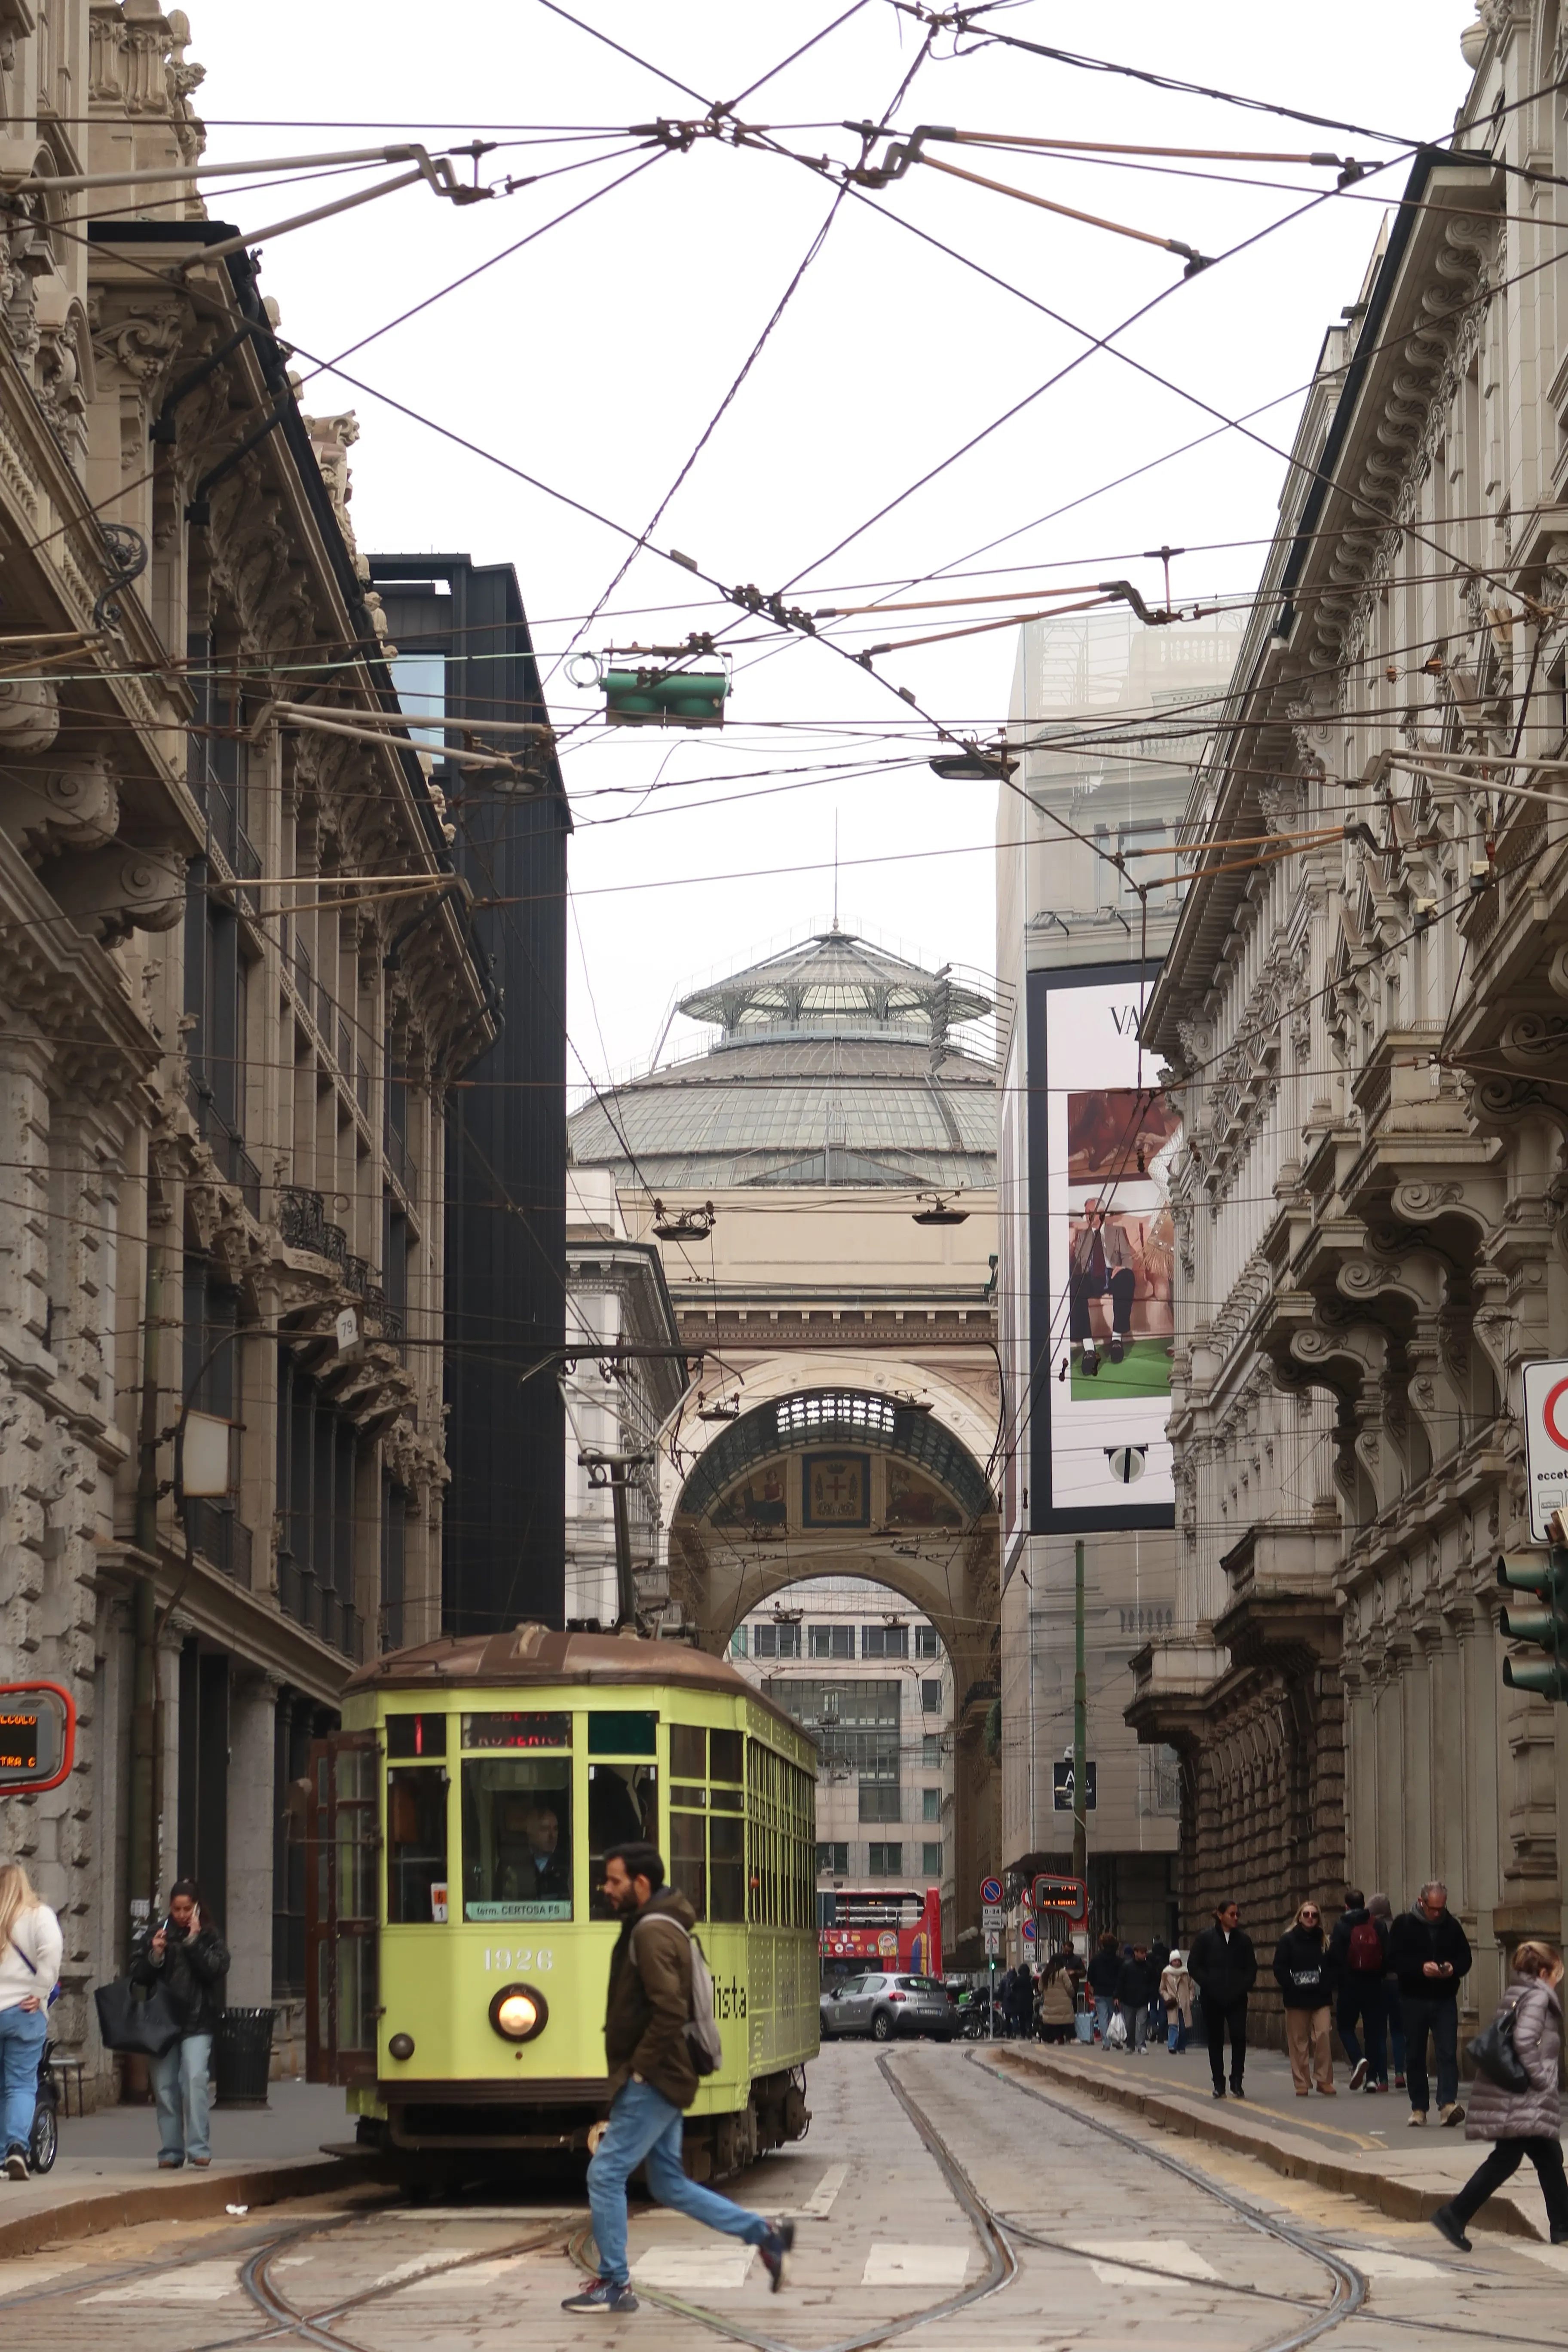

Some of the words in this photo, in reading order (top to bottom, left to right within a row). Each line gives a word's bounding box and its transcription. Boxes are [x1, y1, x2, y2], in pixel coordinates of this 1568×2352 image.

[341, 1320, 353, 1337] 79
[502, 1905, 546, 1916] CERTOSA
[484, 1948, 553, 1971] 1926
